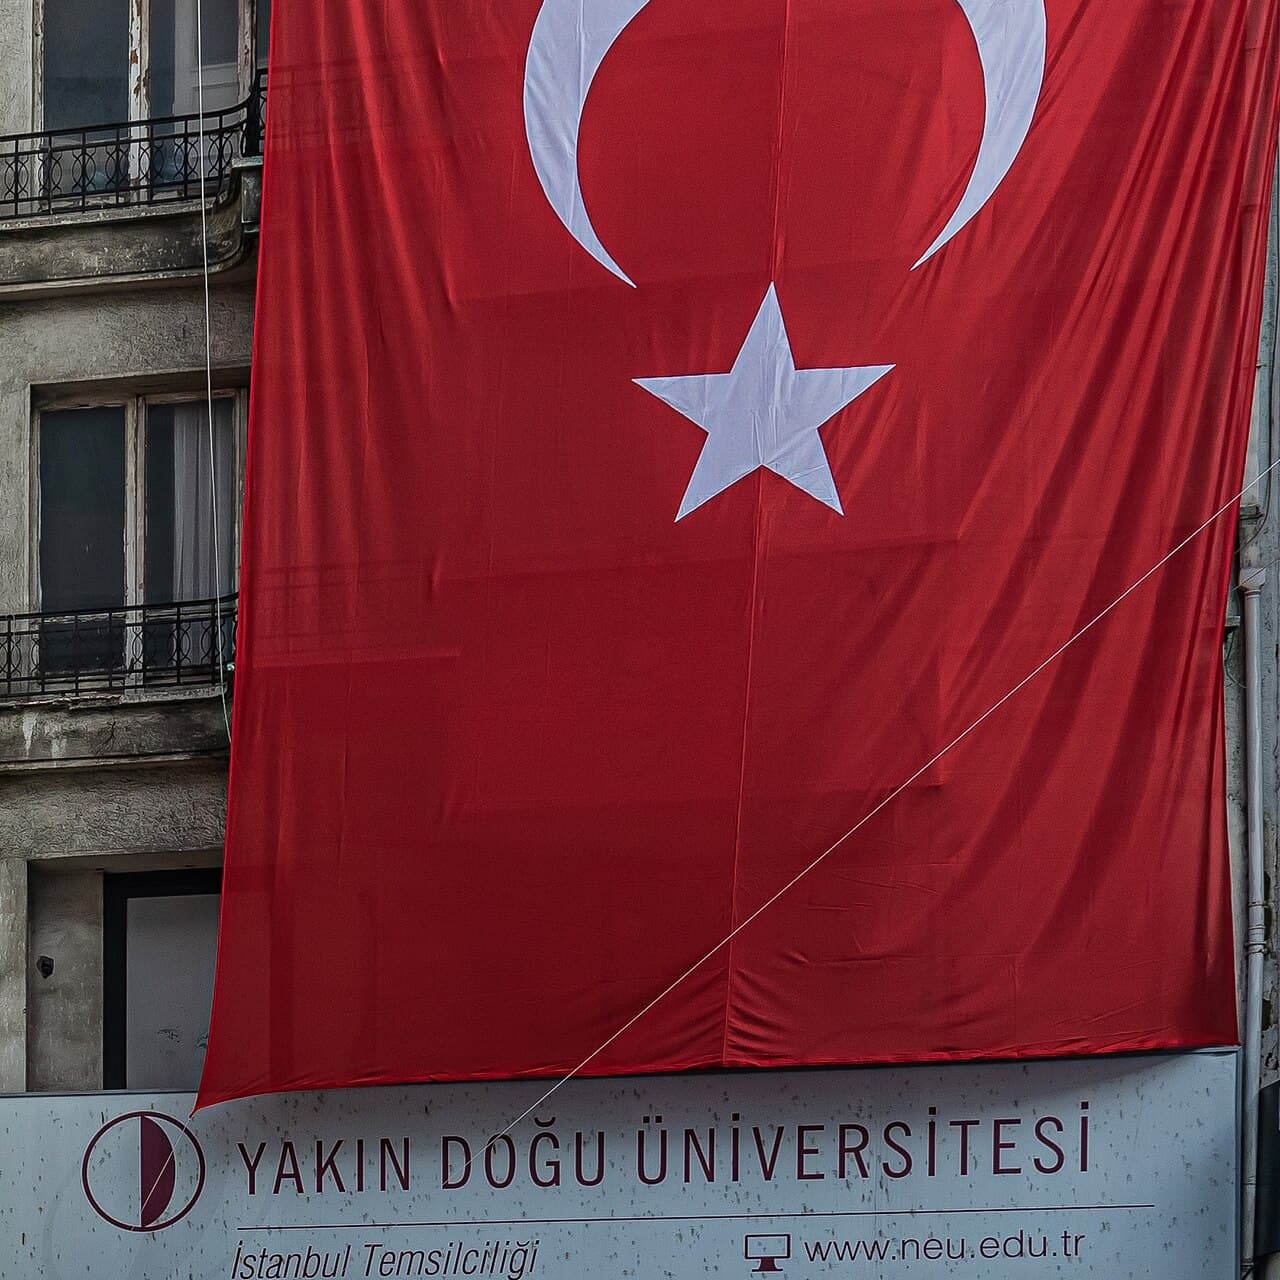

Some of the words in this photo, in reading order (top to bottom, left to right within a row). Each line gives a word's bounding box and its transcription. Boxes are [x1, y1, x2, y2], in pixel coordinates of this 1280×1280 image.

[237, 1136, 411, 1196] YAKIN
[442, 1116, 606, 1190] DOĞU
[637, 1100, 1090, 1186] ÜNİVERSİTESİ
[231, 1240, 352, 1280] İstanbul
[803, 1229, 1087, 1263] www.neu.edu.tr
